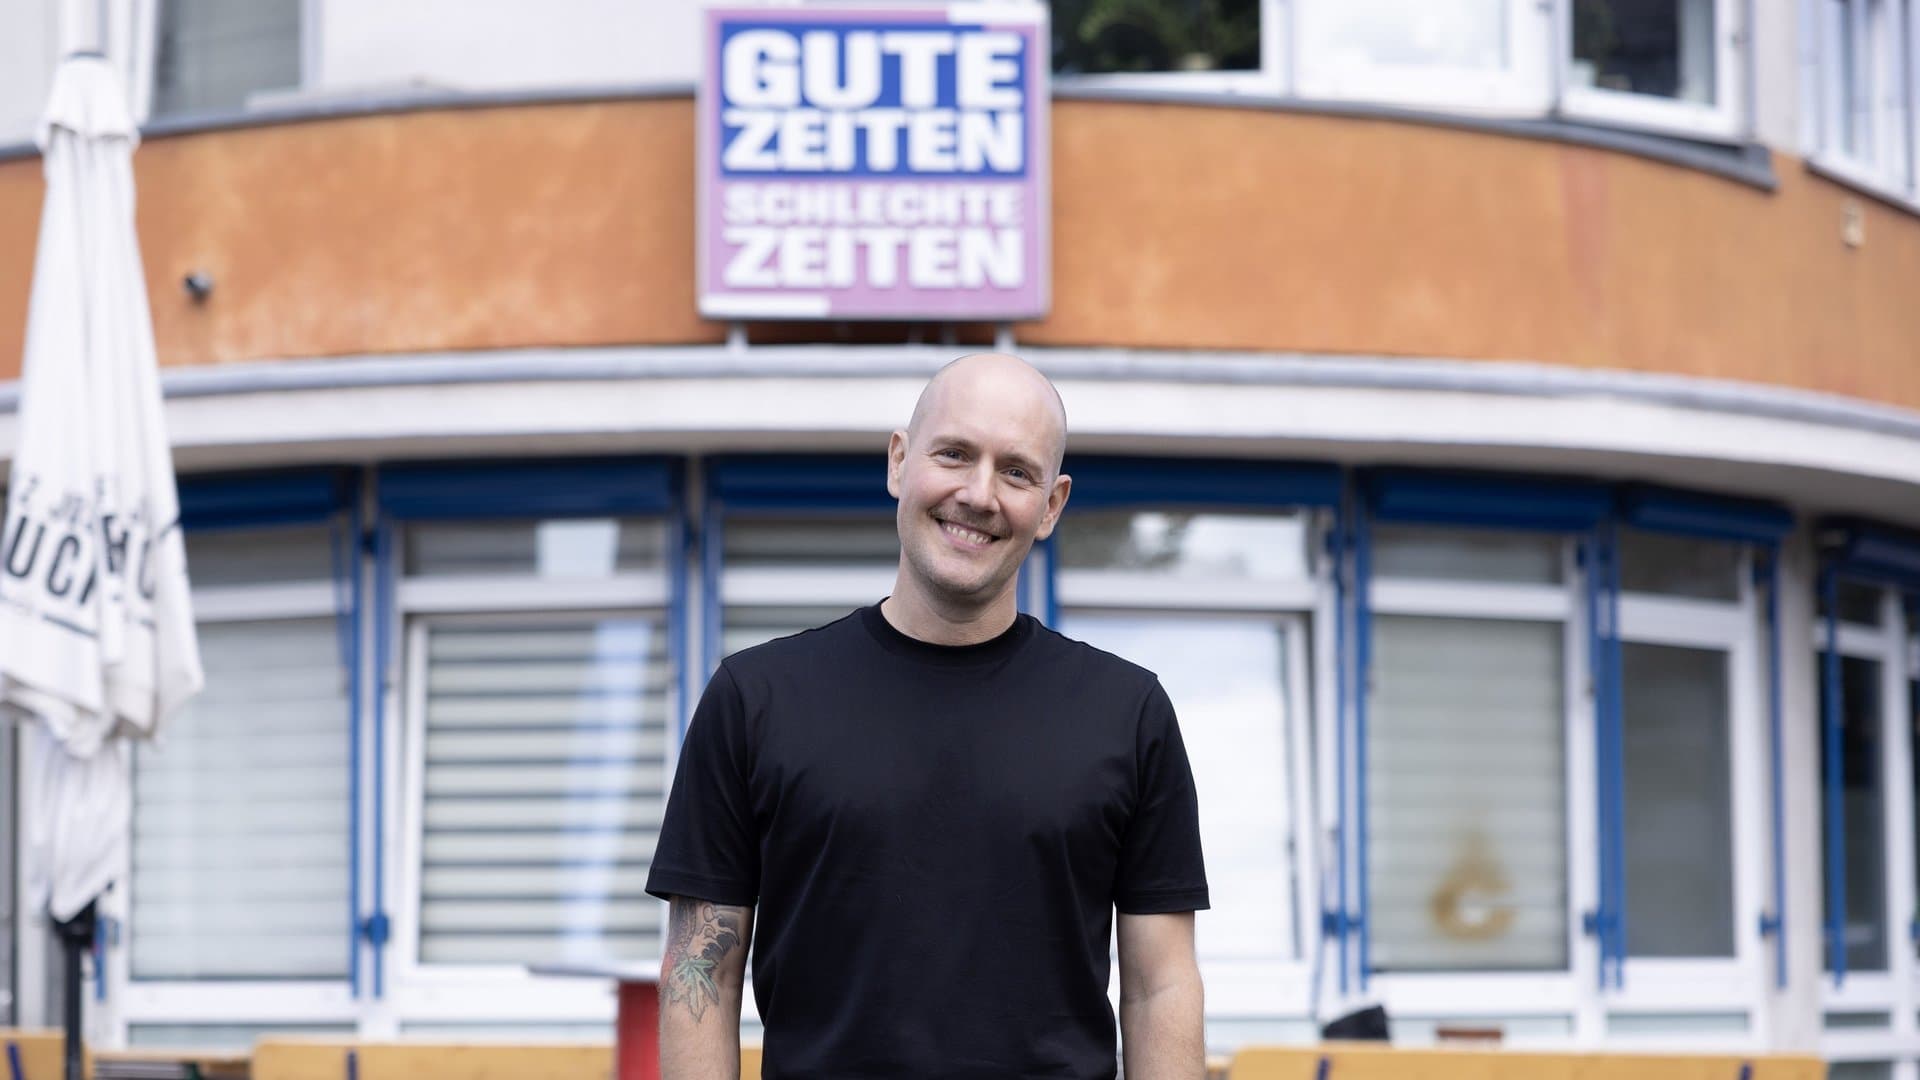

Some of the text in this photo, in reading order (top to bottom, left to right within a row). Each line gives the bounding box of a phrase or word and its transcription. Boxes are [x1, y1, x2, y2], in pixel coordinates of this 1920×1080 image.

[723, 29, 1023, 109] GUTE
[722, 109, 1023, 172] ZEITEN
[723, 184, 1022, 226] SCHLECHTE
[722, 227, 1024, 290] ZEITEN
